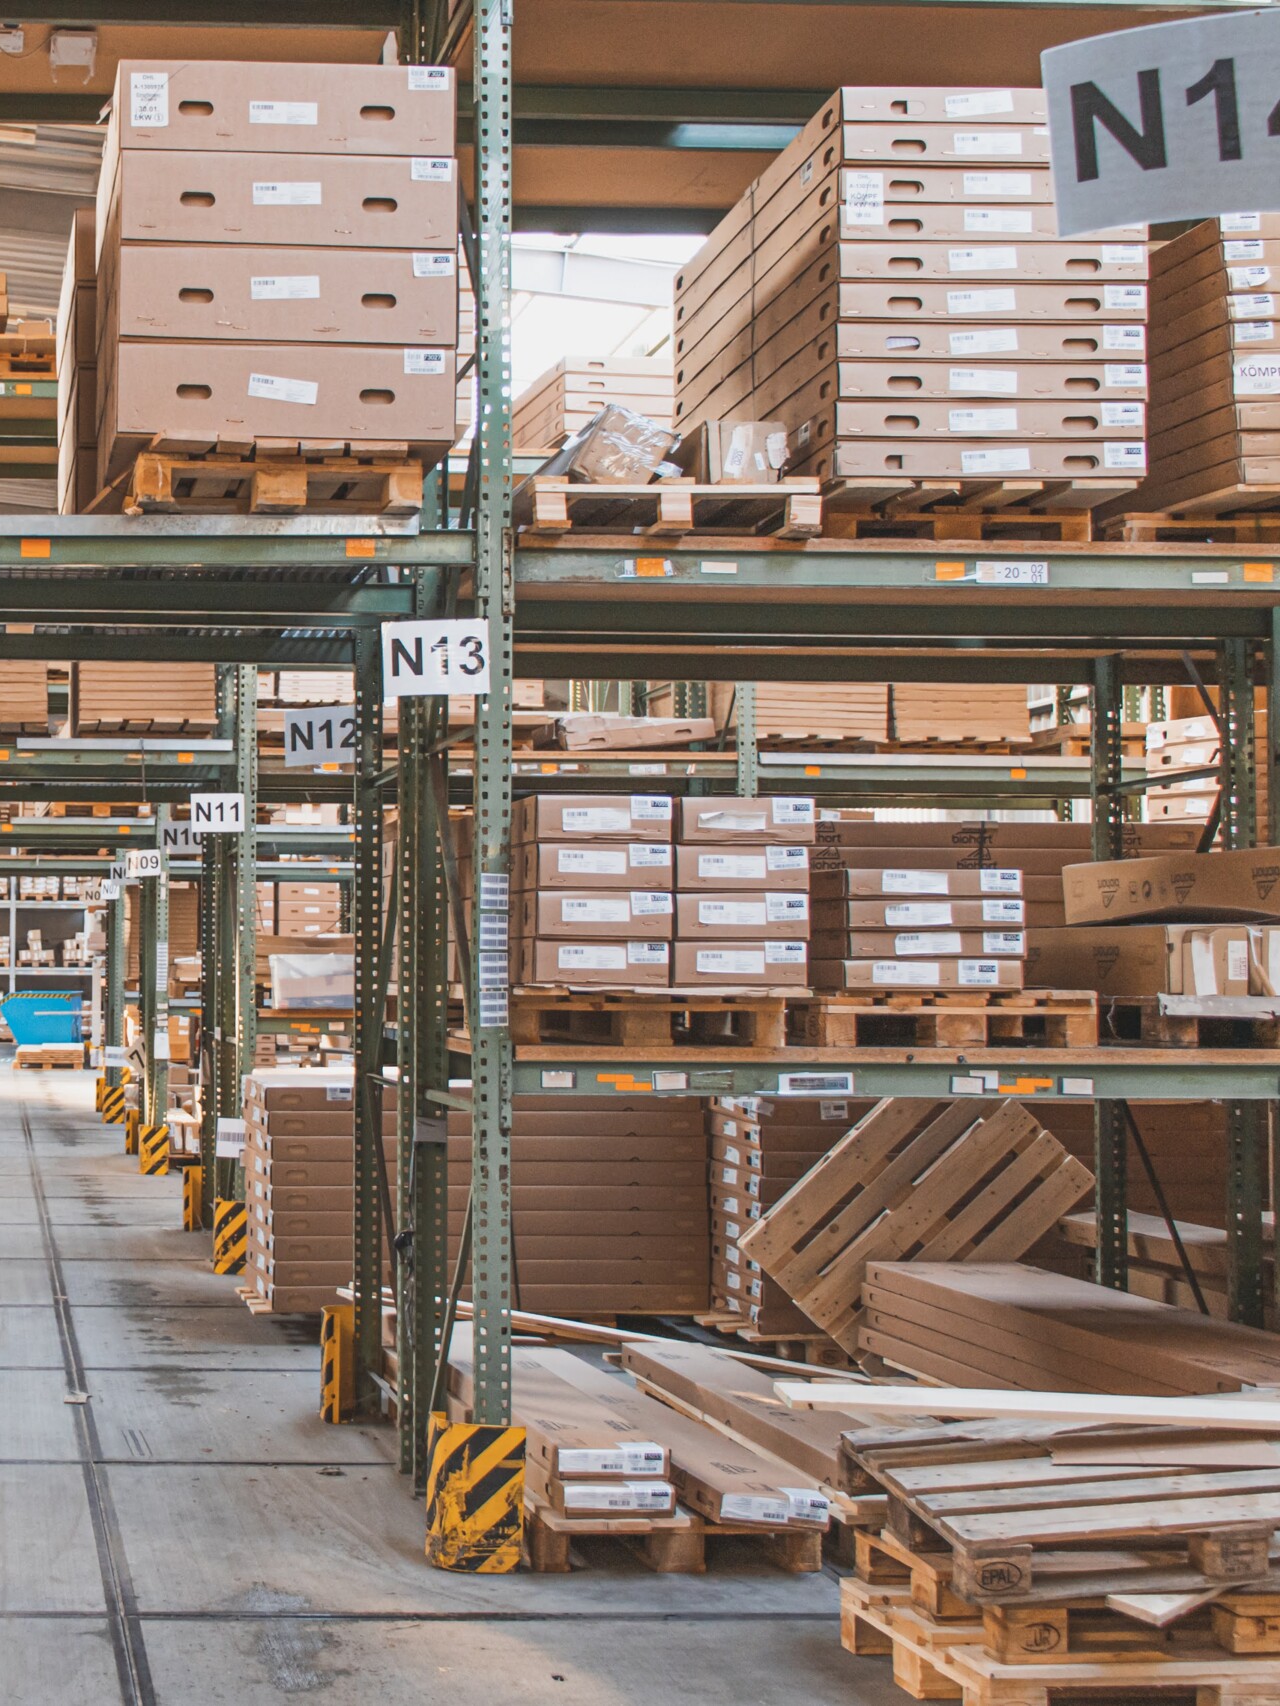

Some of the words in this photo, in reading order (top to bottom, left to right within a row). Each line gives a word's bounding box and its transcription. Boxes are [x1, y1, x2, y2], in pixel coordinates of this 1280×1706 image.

[1239, 364, 1280, 377] KÖMP
[1004, 567, 1020, 579] 20
[1031, 564, 1044, 574] 02
[1031, 574, 1042, 583] 01
[391, 636, 484, 676] N13
[291, 718, 356, 752] N12
[195, 803, 241, 822] N11
[816, 833, 841, 844] hort
[128, 856, 159, 870] N09
[85, 890, 101, 901] N0
[982, 1568, 1015, 1585] EPAL
